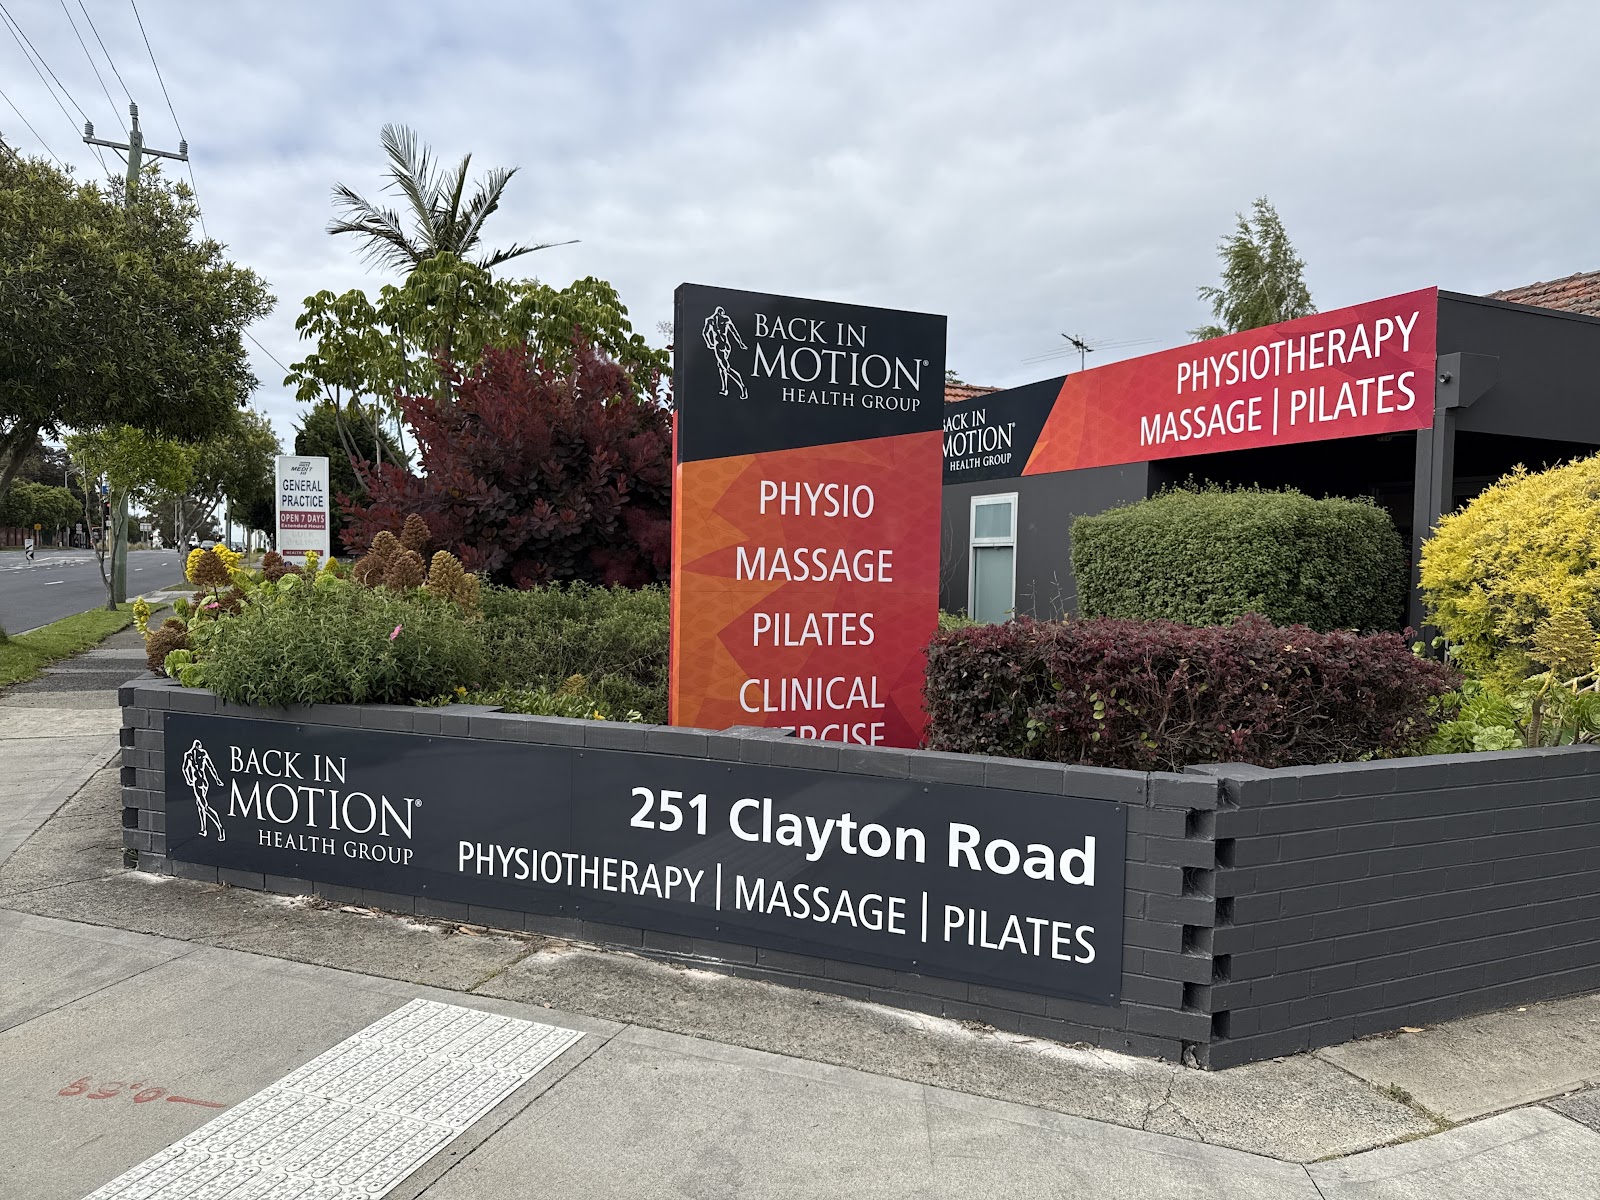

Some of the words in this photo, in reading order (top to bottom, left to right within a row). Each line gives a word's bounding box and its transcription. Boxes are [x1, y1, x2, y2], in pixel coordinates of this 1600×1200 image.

[754, 313, 828, 344] BACK
[837, 322, 867, 348] IN
[1177, 311, 1420, 394] PHYSIOTHERAPY
[782, 387, 855, 407] HEALTH
[861, 394, 921, 412] GROUP
[971, 408, 986, 427] IN
[1140, 396, 1263, 447] MASSAGE
[1289, 371, 1416, 426] PILATES
[949, 457, 981, 472] HEALTH
[982, 452, 1012, 467] GROUP
[282, 495, 323, 507] PRACTICE
[283, 479, 322, 492] GENERAL
[759, 480, 875, 519] PHYSIO
[281, 513, 299, 522] OPEN
[301, 514, 306, 522] 7
[307, 514, 324, 523] DAYS
[736, 546, 893, 583] MASSAGE
[753, 612, 875, 647] PILATES
[739, 675, 885, 713] CLINICAL
[229, 745, 305, 780] BACK
[313, 754, 347, 784] IN
[258, 829, 336, 856] HEALTH
[343, 840, 414, 866] GROUP
[630, 786, 707, 836] 251
[729, 797, 926, 864] Clayton
[948, 822, 1096, 887] Road
[458, 840, 705, 903] PHYSIOTHERAPY
[735, 874, 906, 935] MASSAGE
[944, 904, 1096, 964] PILATES
